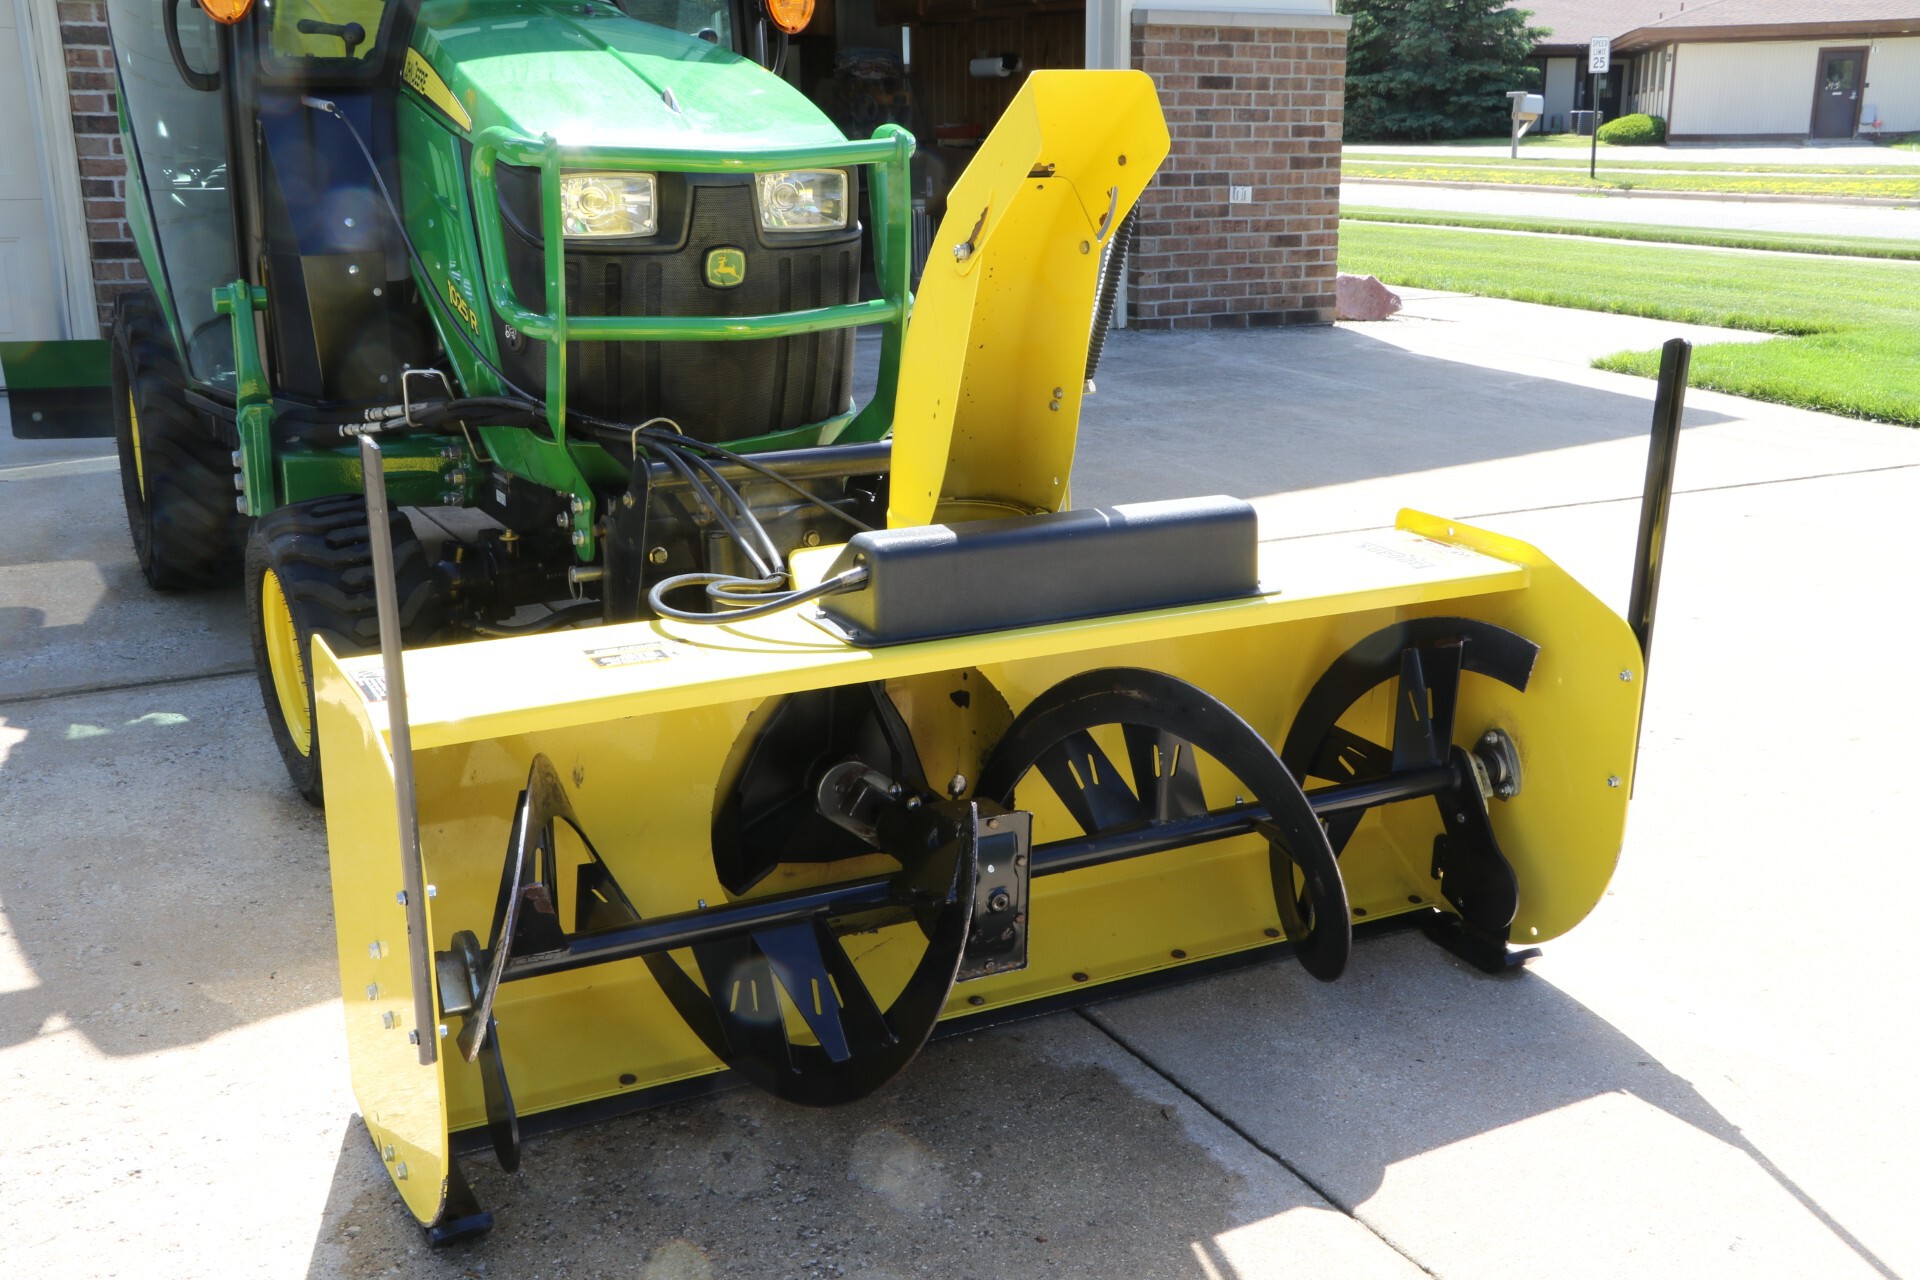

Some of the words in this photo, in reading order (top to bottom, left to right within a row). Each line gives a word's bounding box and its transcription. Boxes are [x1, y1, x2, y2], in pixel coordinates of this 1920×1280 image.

[1592, 39, 1608, 48] SPEED
[1592, 48, 1606, 56] LIMIT
[1593, 57, 1606, 69] 25
